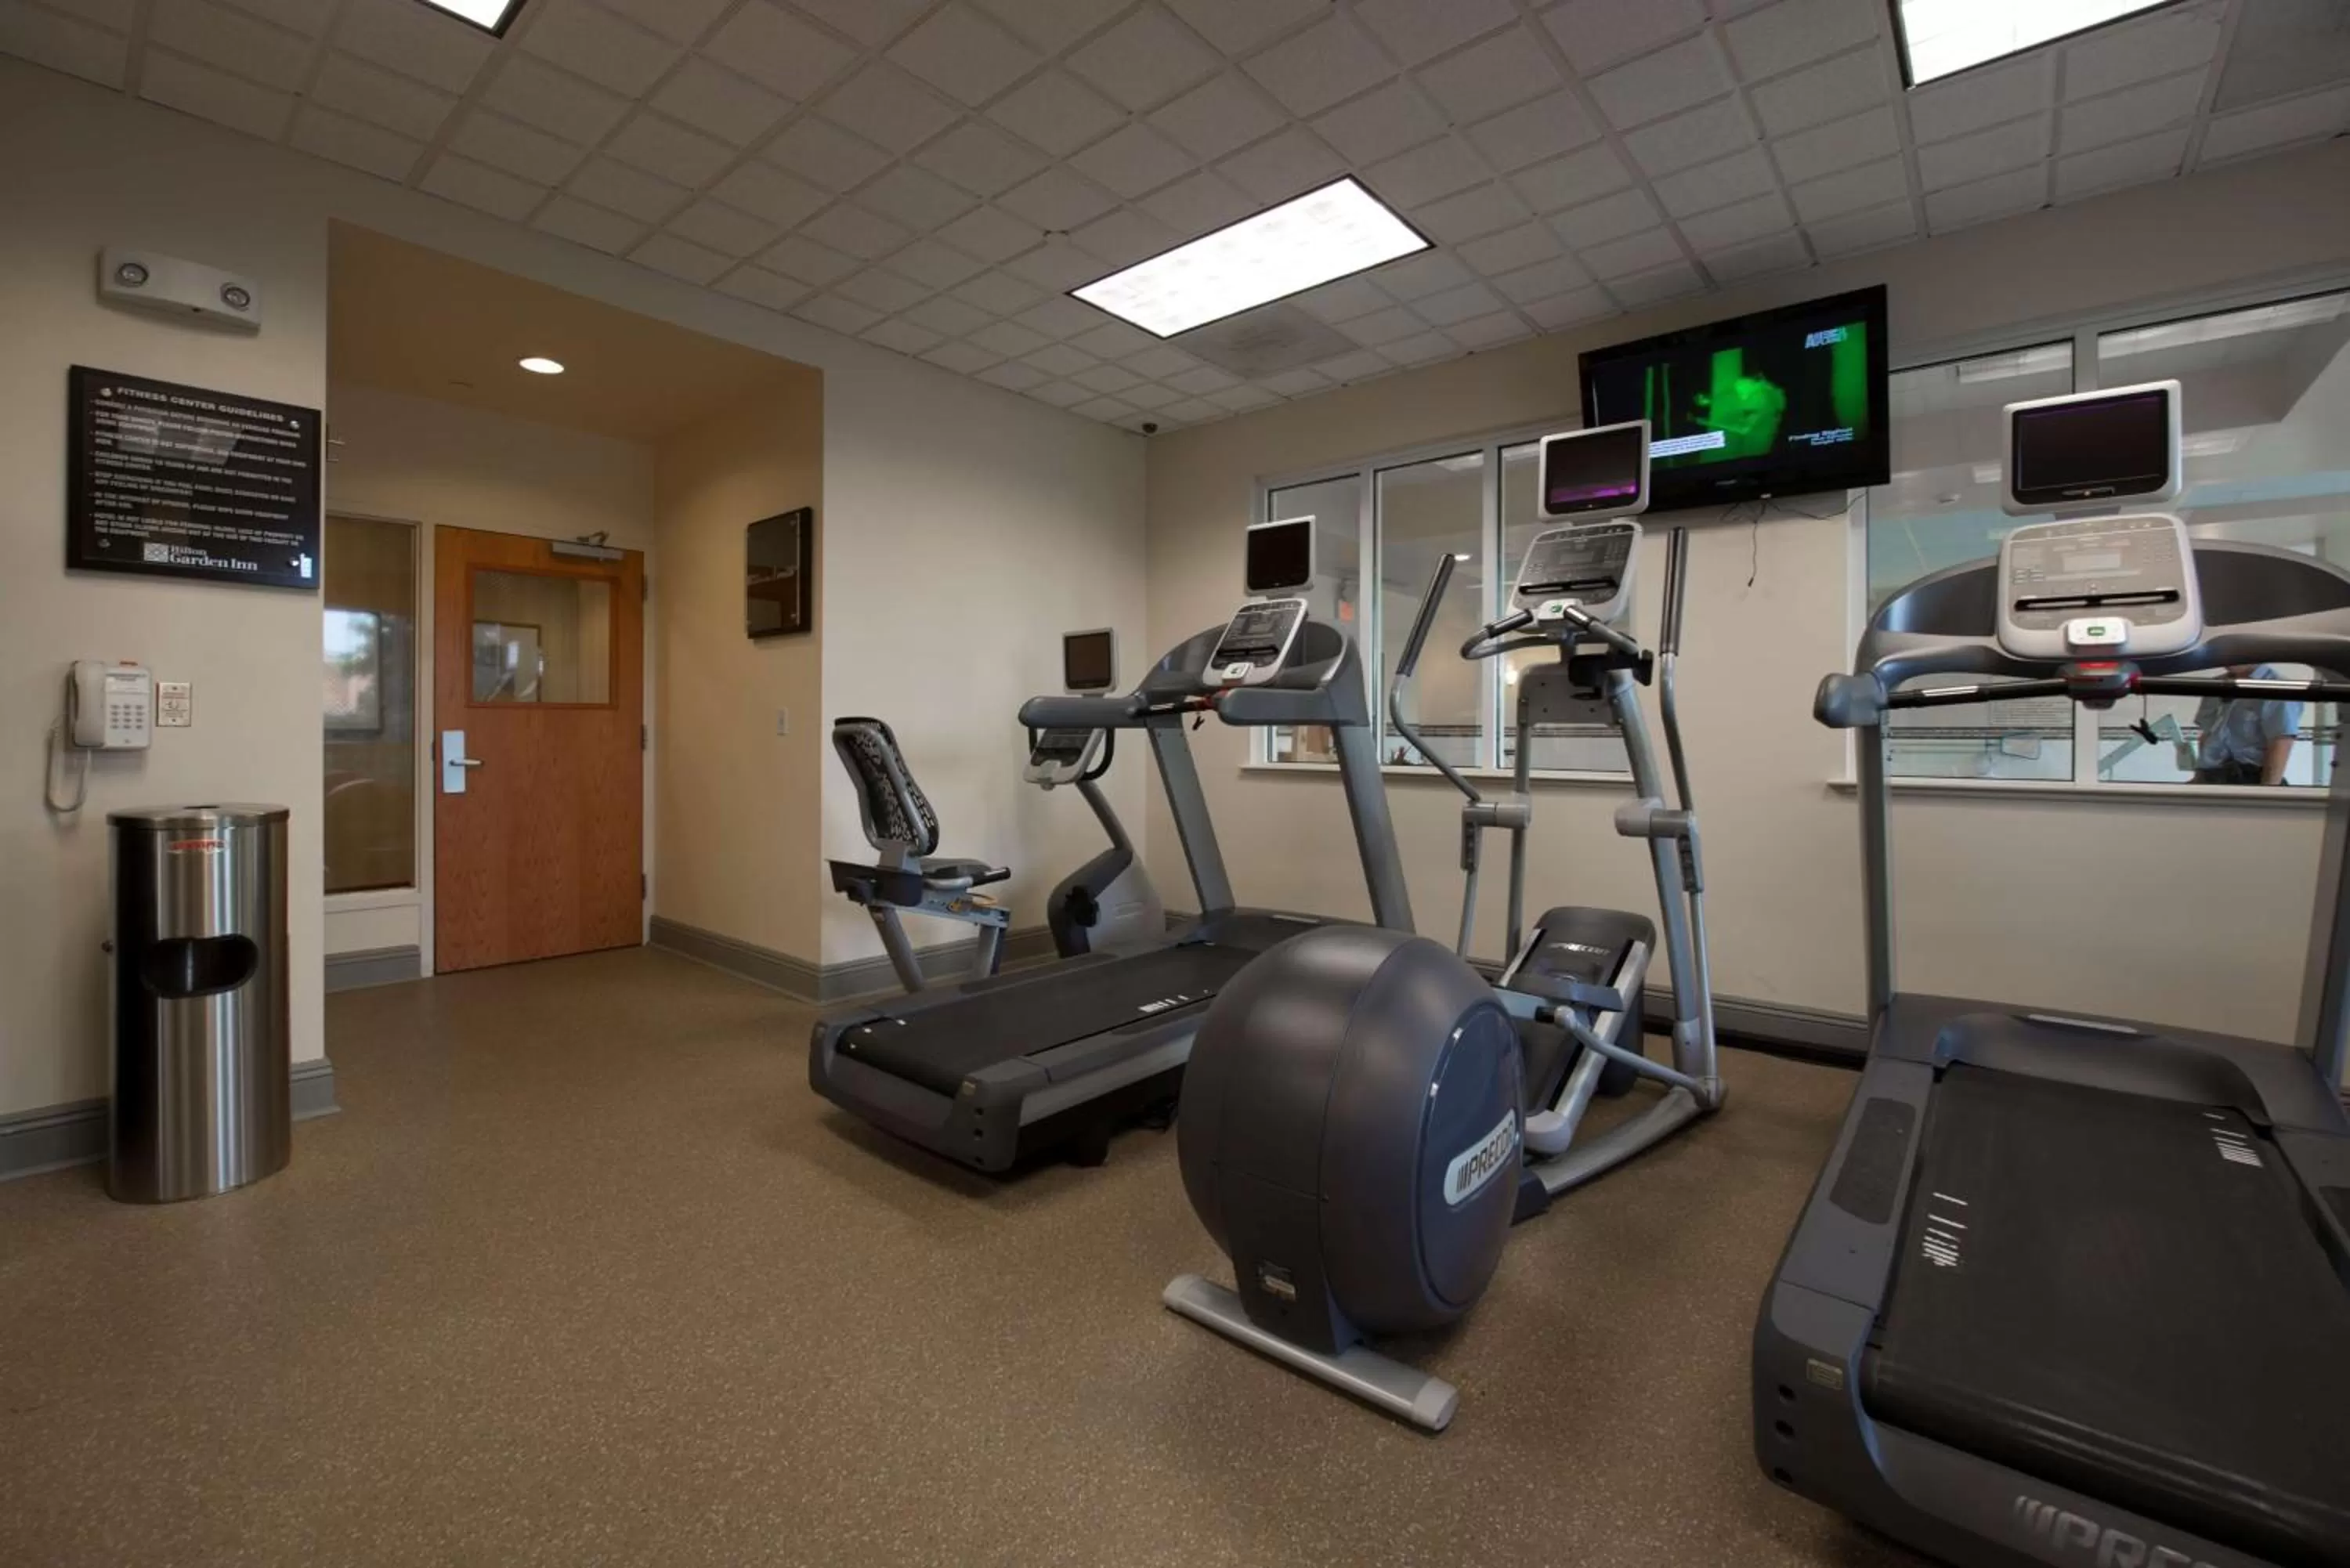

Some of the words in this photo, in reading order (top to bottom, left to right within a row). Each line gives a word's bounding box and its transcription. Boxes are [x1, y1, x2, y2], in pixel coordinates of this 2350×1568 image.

[170, 396, 216, 410] CENTER
[218, 404, 284, 422] GUIDELINES
[170, 554, 228, 568] Garden
[231, 558, 258, 571] Inn
